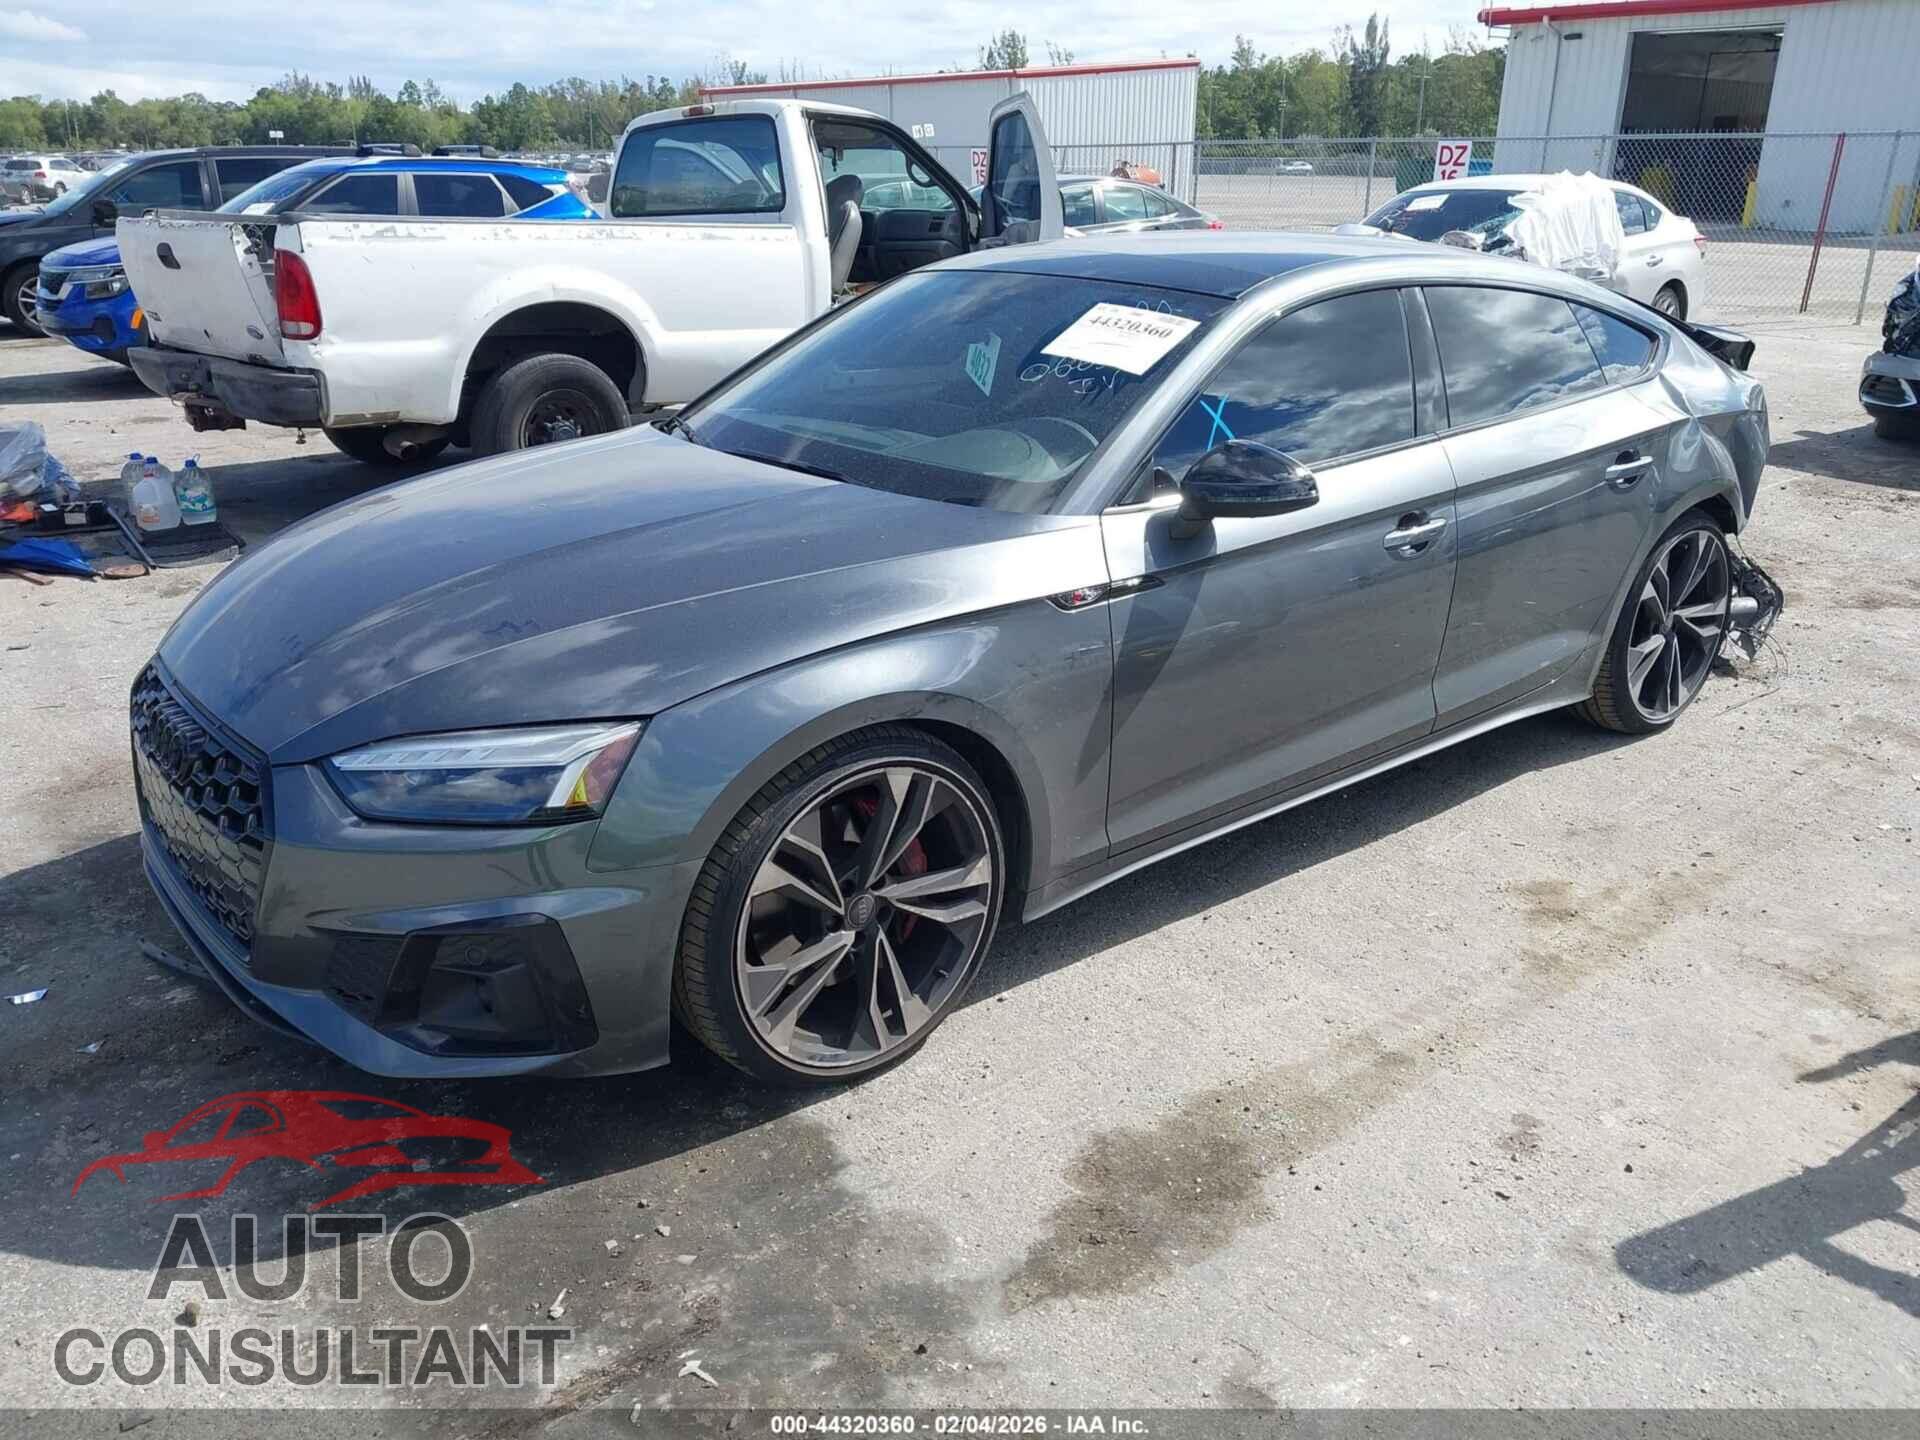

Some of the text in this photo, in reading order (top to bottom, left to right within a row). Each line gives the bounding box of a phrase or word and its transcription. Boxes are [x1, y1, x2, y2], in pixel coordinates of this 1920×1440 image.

[972, 151, 987, 167] DZ
[1439, 145, 1468, 166] DZ
[976, 170, 986, 184] 15
[1088, 316, 1174, 338] 44320360
